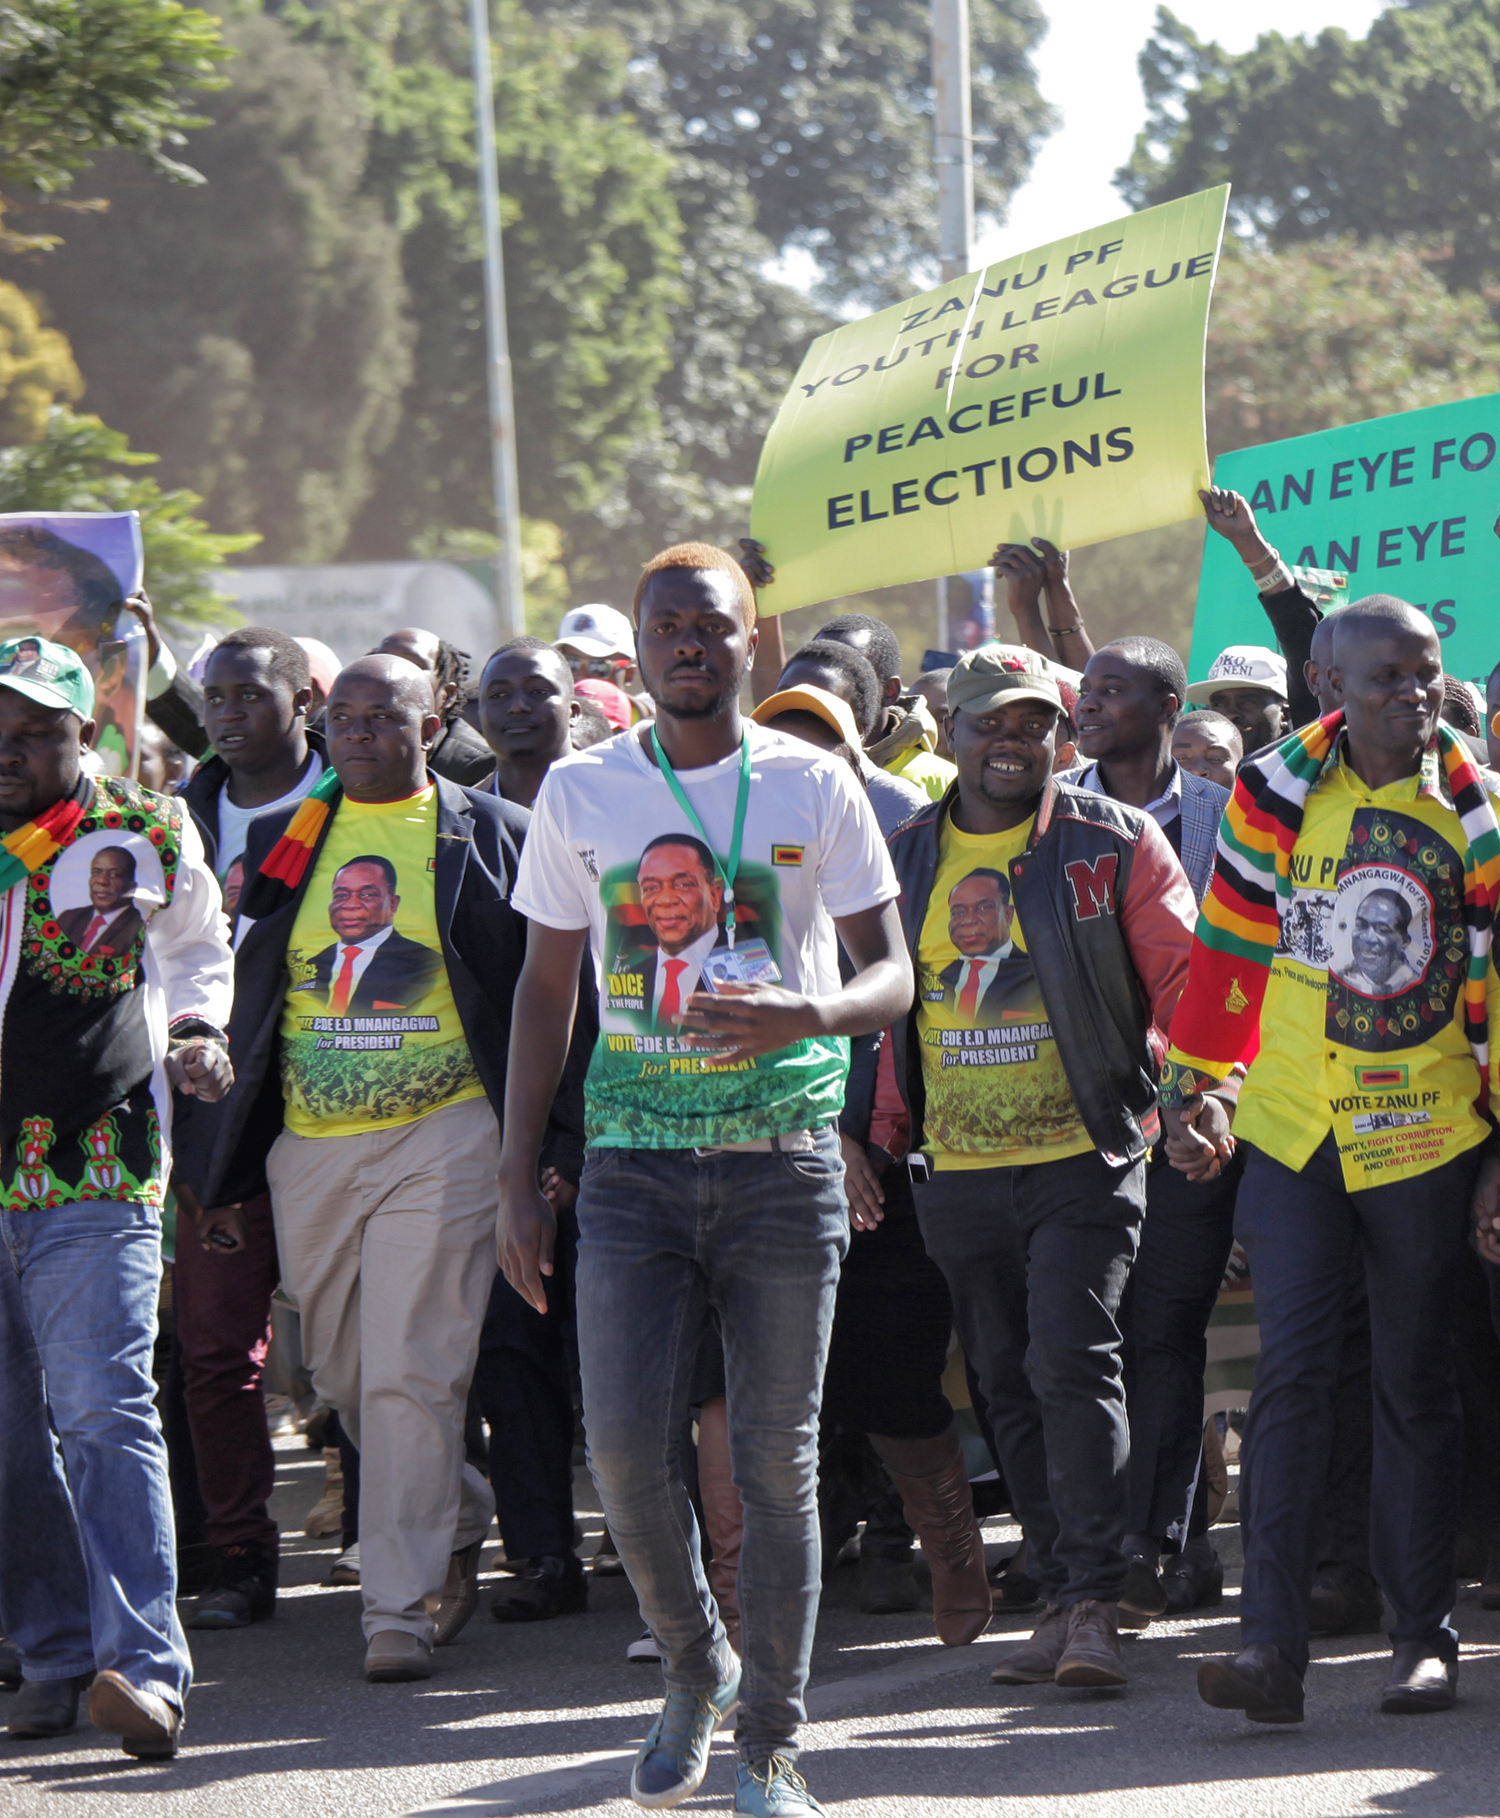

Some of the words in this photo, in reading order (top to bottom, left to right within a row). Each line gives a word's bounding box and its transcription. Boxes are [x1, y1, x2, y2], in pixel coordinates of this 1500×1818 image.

[899, 265, 1048, 334] ZANU
[1065, 239, 1125, 276] PF
[799, 319, 983, 398] YOUTH
[1000, 252, 1215, 331] LEAGUE
[934, 343, 1040, 390] FOR
[843, 372, 1122, 463] PEACEFUL
[827, 426, 1135, 530] ELECTIONS
[1251, 469, 1314, 514] AN
[1328, 449, 1415, 502] EYE
[1296, 536, 1360, 573] AN
[1376, 516, 1467, 568] EYE
[1064, 852, 1119, 922] M
[1337, 869, 1405, 896] MNANGAGWA
[1405, 881, 1421, 897] for
[1416, 941, 1432, 968] 2018
[313, 1017, 333, 1031] CDE
[335, 1018, 352, 1031] E.D
[354, 1017, 438, 1031] MNANGAGWA
[941, 1028, 962, 1046] CDE
[965, 1029, 984, 1045] E.D
[316, 1037, 333, 1050] for
[335, 1036, 402, 1049] PRESIDENT
[607, 1035, 635, 1052] VOTE
[635, 1036, 663, 1053] CDE
[638, 1060, 667, 1078] for
[941, 1053, 960, 1069] for
[961, 1046, 1036, 1065] PRESIDENT
[1329, 1096, 1372, 1114] VOTE
[1374, 1093, 1418, 1109] ZANU
[1422, 1091, 1441, 1107] PF
[1338, 1141, 1367, 1154] UNITY,
[1368, 1135, 1393, 1148] FIGHT
[1396, 1126, 1455, 1142] CORRUPTION,
[1353, 1147, 1394, 1163] DEVELOP,
[1395, 1138, 1445, 1154] RE-ENGAGE
[1364, 1160, 1383, 1172] AND
[1384, 1153, 1417, 1168] CREATE
[1419, 1150, 1440, 1163] JOBS
